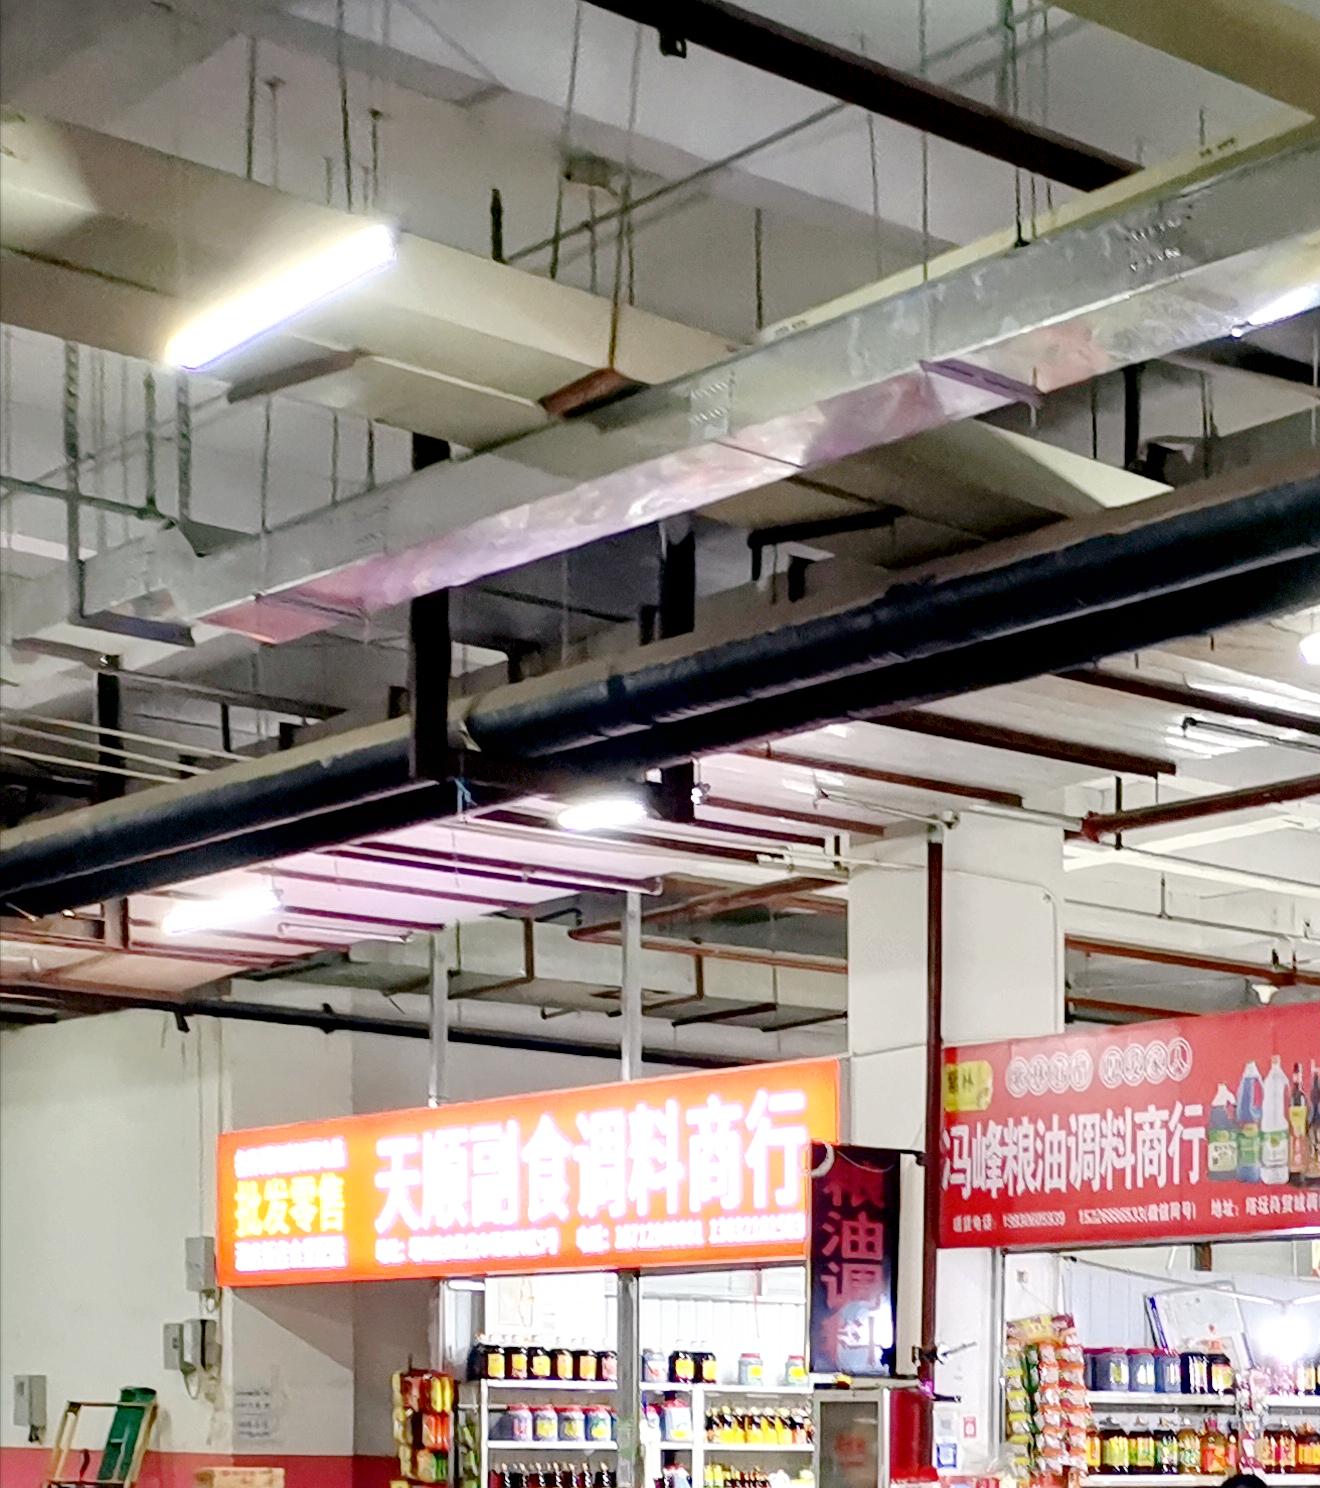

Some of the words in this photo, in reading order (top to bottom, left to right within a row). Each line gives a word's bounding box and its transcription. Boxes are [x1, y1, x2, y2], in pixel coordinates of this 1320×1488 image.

[941, 1100, 1206, 1200] 冯峰粮油调料商行
[234, 1172, 346, 1237] 批发零售
